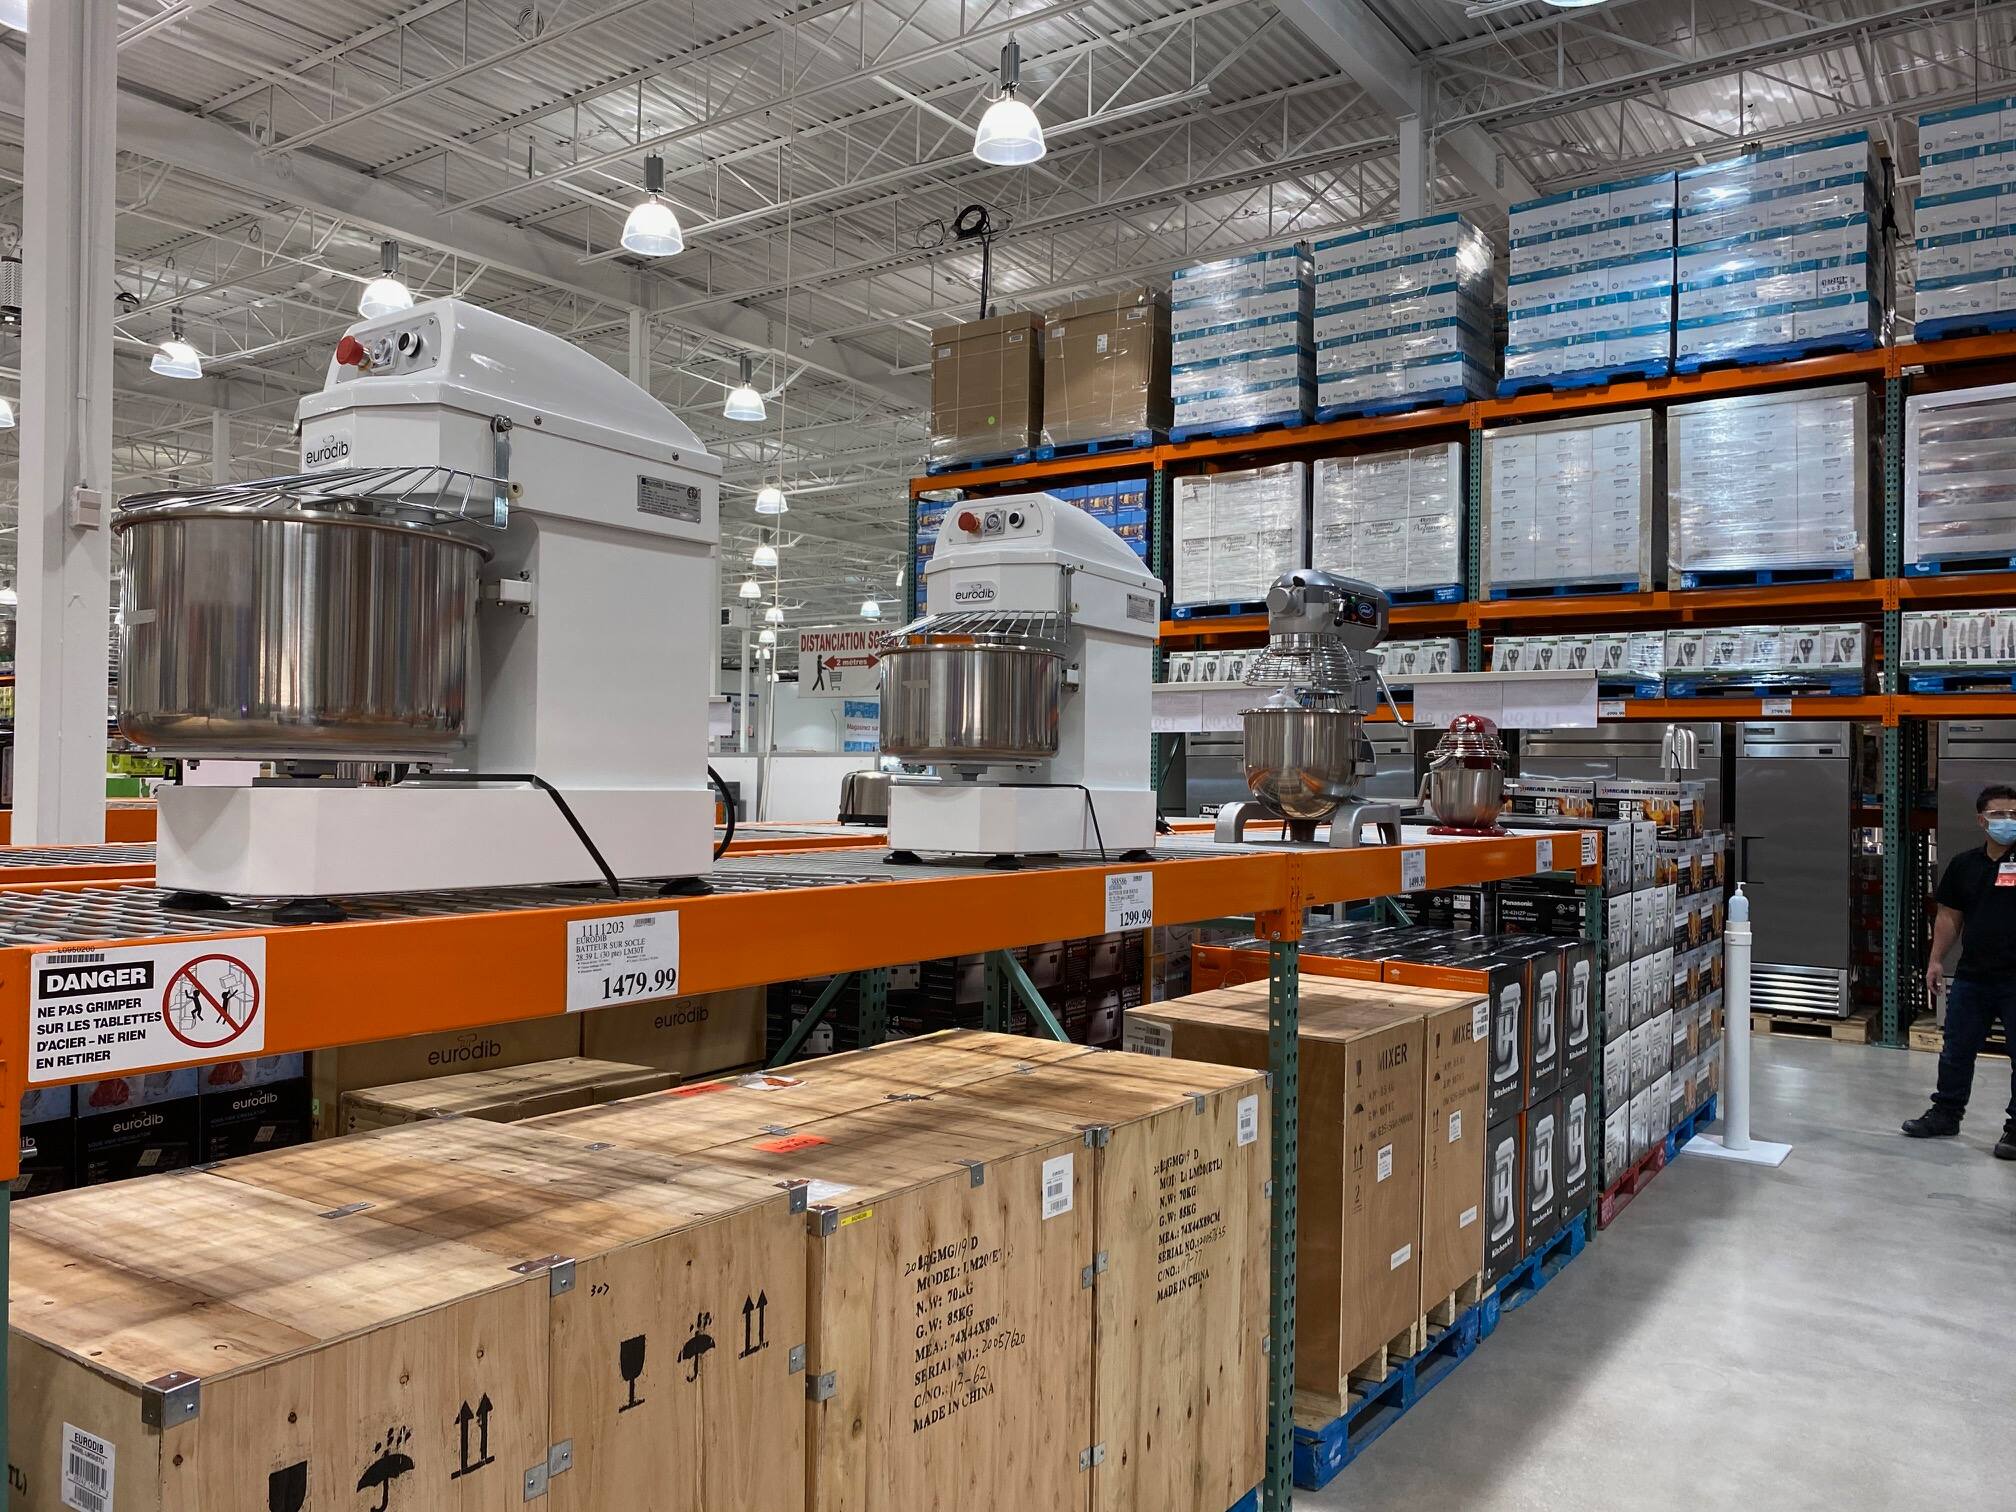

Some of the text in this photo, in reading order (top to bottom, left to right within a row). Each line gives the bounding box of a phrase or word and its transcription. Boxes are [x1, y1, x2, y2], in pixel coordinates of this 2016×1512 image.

[306, 441, 349, 466] eurodib
[955, 587, 995, 601] eurodib
[801, 632, 865, 652] DISTANCIATION
[1502, 899, 1533, 907] Panasonic
[582, 921, 625, 937] 1111203
[1120, 909, 1152, 927] 1299.99
[576, 934, 607, 945] EURODIB
[576, 938, 646, 954] BATTEUR SUR SOCLE
[576, 953, 593, 962] 28.39
[46, 967, 147, 993] DANGER
[602, 967, 677, 1000] 1479.99
[37, 998, 142, 1019] NE PAS GRIMPER
[654, 1006, 709, 1029] eurodib
[37, 1011, 162, 1036] SUR LES TABLETTES
[1452, 1021, 1473, 1046] MIXE
[37, 1036, 86, 1053] D'ACIER
[97, 1033, 115, 1046] NE
[117, 1029, 146, 1042] RIEN
[36, 1050, 111, 1070] EN RETIRER
[428, 1039, 502, 1066] eurodib
[1378, 1043, 1408, 1073] MIXER
[232, 1092, 278, 1110] eurodib
[1494, 1081, 1518, 1099] KitchenAid
[112, 1114, 164, 1133] eurodib
[1159, 1185, 1197, 1210] N.W: 70KG
[1159, 1211, 1176, 1227] G.W:
[1532, 1206, 1553, 1228] KitchenAid
[971, 1235, 979, 1250] D
[1158, 1230, 1180, 1247] MEA.:
[1492, 1235, 1514, 1259] KitchenAid
[1157, 1244, 1184, 1264] SERIAL
[916, 1265, 961, 1294] MODEL:
[1157, 1265, 1180, 1282] C/NO.:
[1156, 1268, 1210, 1304] MADE IN CHINA
[915, 1295, 942, 1318] N.W:
[915, 1303, 974, 1339] G.W: 85KG
[914, 1340, 947, 1363] MEA.:
[913, 1382, 995, 1434] MADE IN CHINA
[914, 1385, 948, 1409] C/NO.:
[74, 1432, 104, 1454] EURODIB
